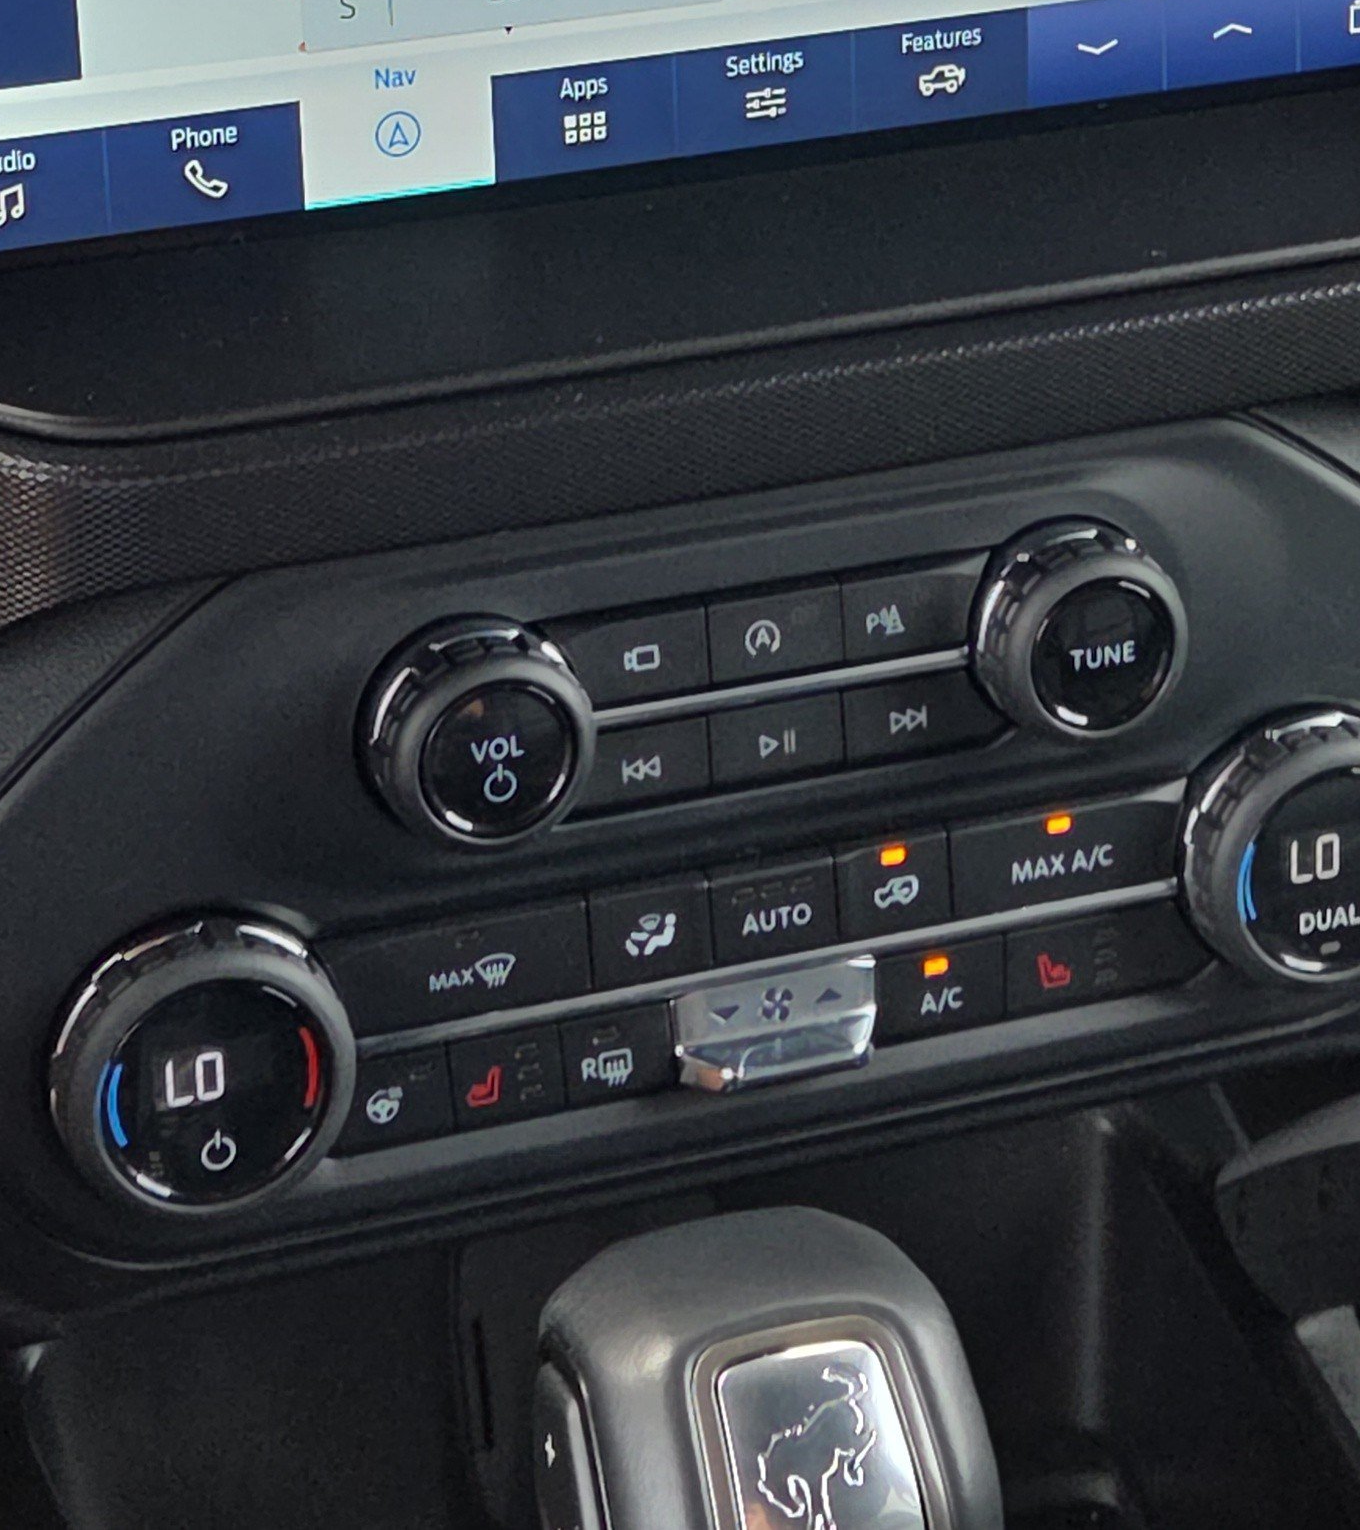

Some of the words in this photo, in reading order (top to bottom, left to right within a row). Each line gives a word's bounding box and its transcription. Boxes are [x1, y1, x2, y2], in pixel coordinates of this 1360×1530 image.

[901, 27, 982, 54] Features
[726, 49, 804, 77] Settings
[374, 67, 416, 90] Nav
[559, 77, 608, 101] Apps
[170, 126, 238, 151] Phone
[1069, 640, 1136, 671] TUNE
[470, 735, 525, 762] VOL
[1011, 853, 1065, 884] MAX
[1071, 843, 1113, 873] A/C
[742, 902, 812, 936] AUTO
[429, 967, 475, 992] MAX
[920, 986, 963, 1015] A/C
